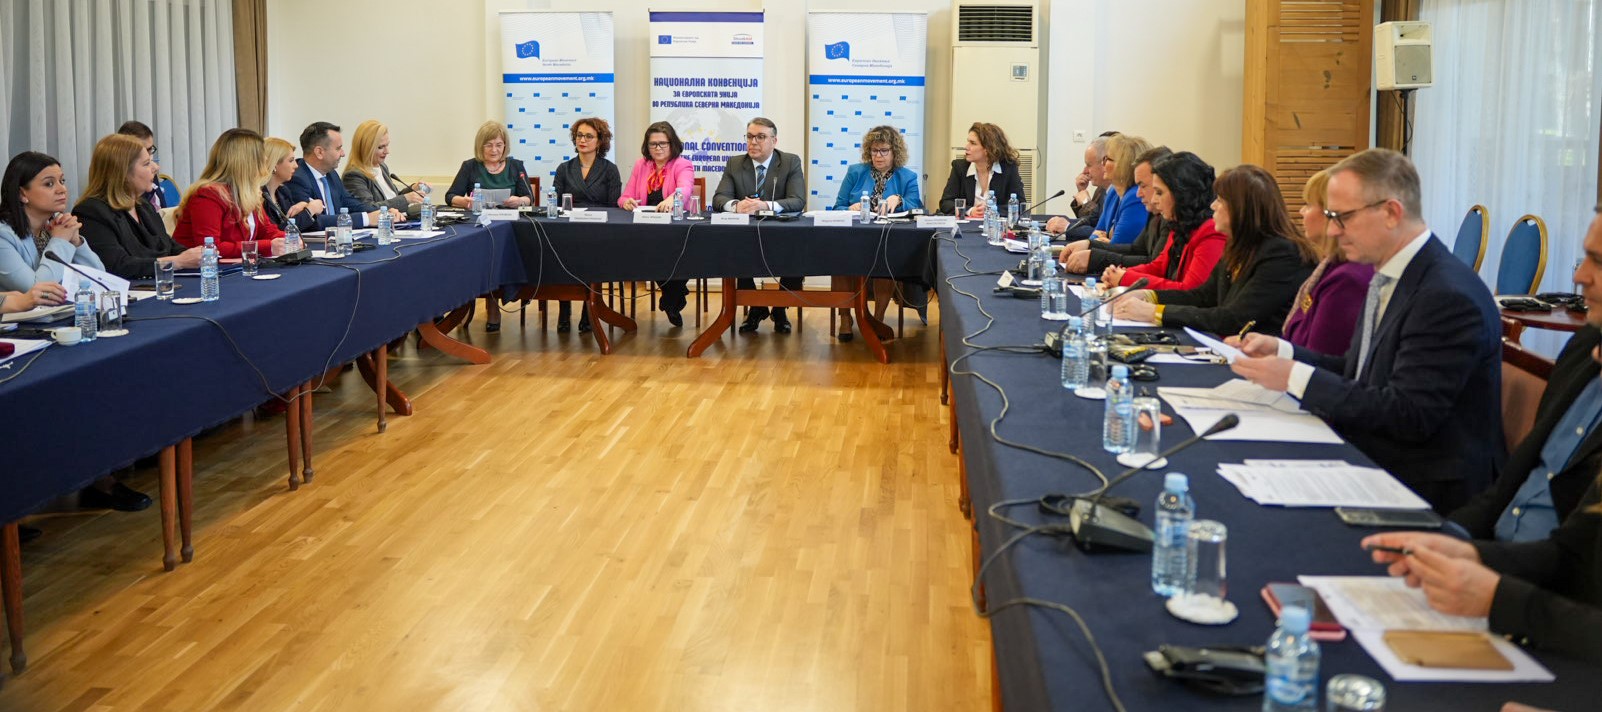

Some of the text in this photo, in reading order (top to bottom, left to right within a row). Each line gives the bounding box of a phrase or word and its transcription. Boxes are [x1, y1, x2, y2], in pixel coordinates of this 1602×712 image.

[653, 77, 758, 88] НАЦИОНАЛНА КОНВЕНЦИЈА
[652, 100, 760, 109] ВО РЕПУБЛИКА СЕВЕРНА МАКЕДОНИЈА
[701, 142, 748, 151] CONVENTION
